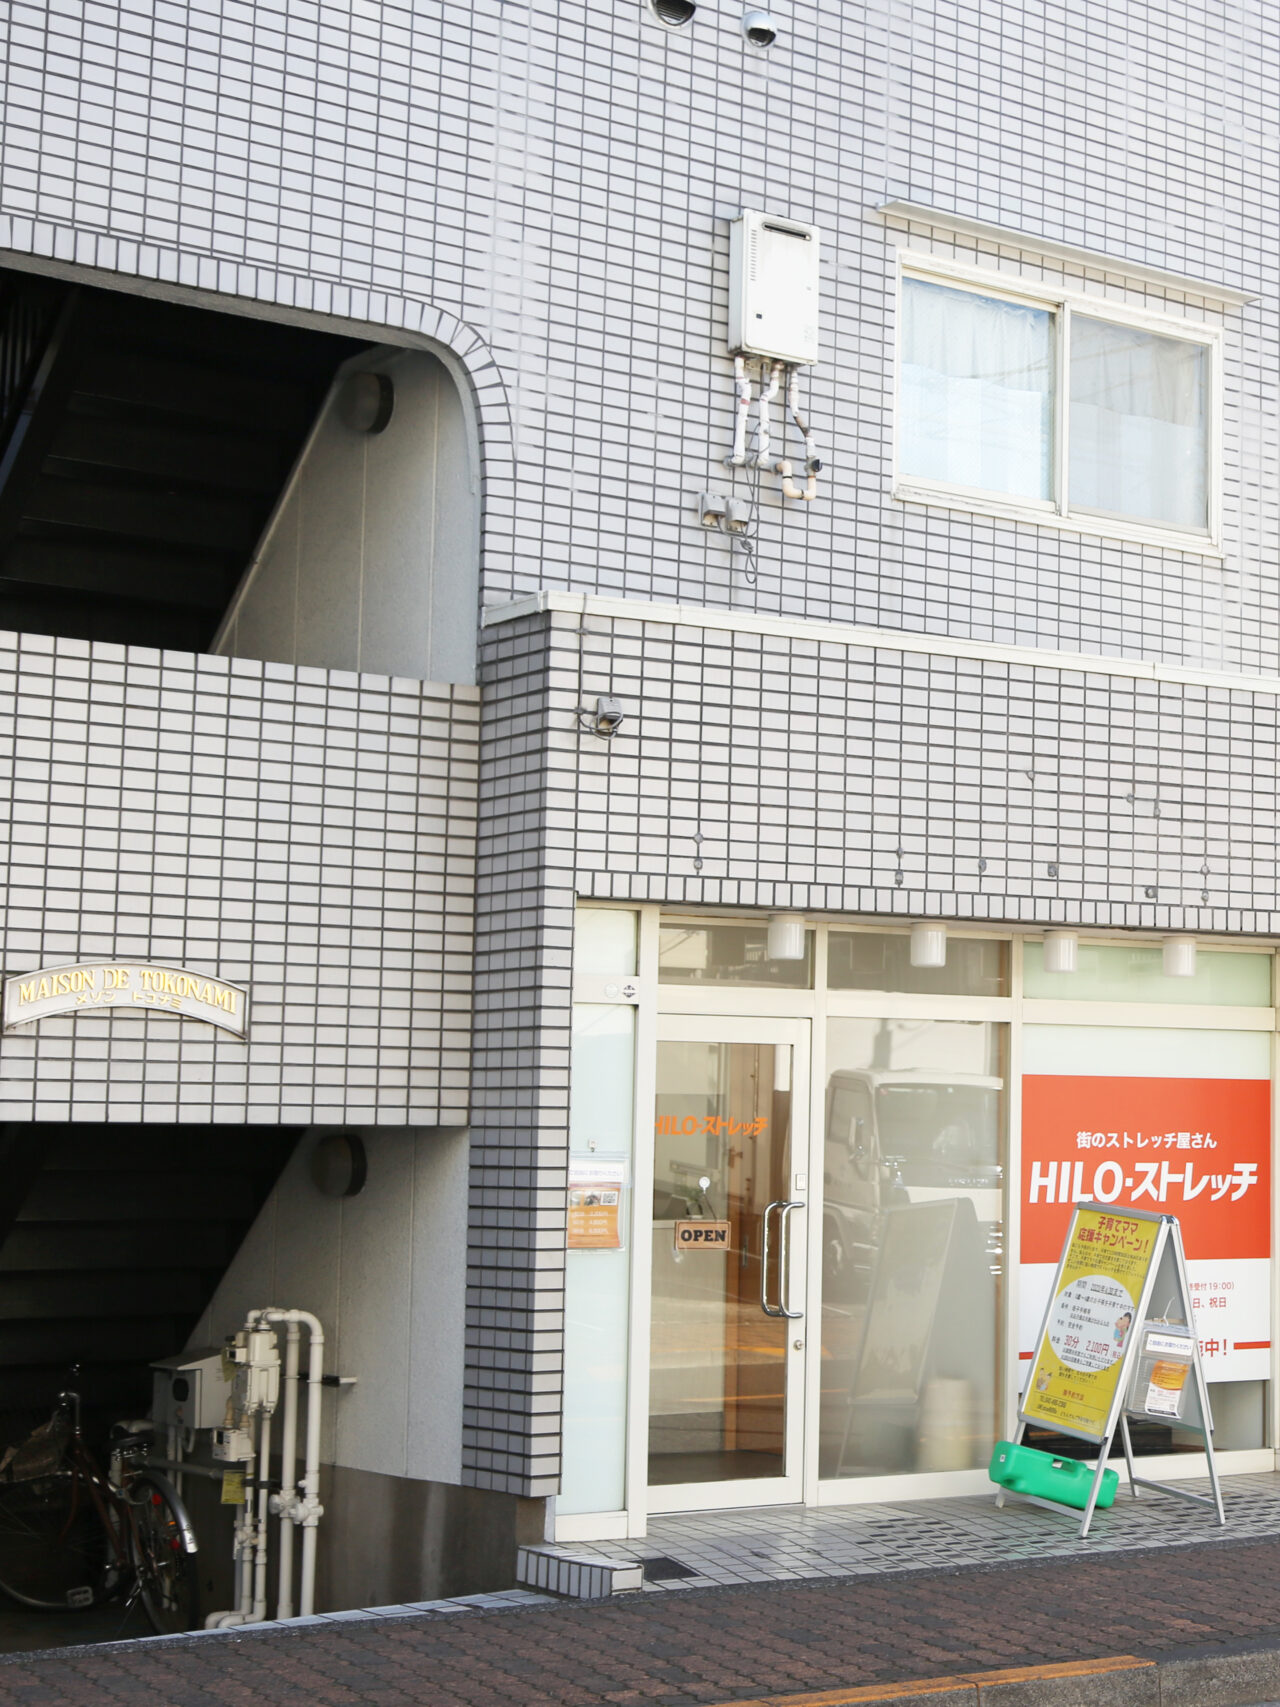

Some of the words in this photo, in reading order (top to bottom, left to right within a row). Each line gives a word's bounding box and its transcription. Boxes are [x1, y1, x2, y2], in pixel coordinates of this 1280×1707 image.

[19, 969, 96, 1006] MAISON
[103, 968, 130, 990] DE
[141, 969, 238, 1015] TOKONAMI
[76, 991, 117, 1005] メゾン
[132, 991, 183, 1009] トコナミ
[1076, 1131, 1218, 1150] 街のストレッチ屋さん
[1098, 1216, 1139, 1235] 子育てママ
[680, 1229, 727, 1243] OPEN
